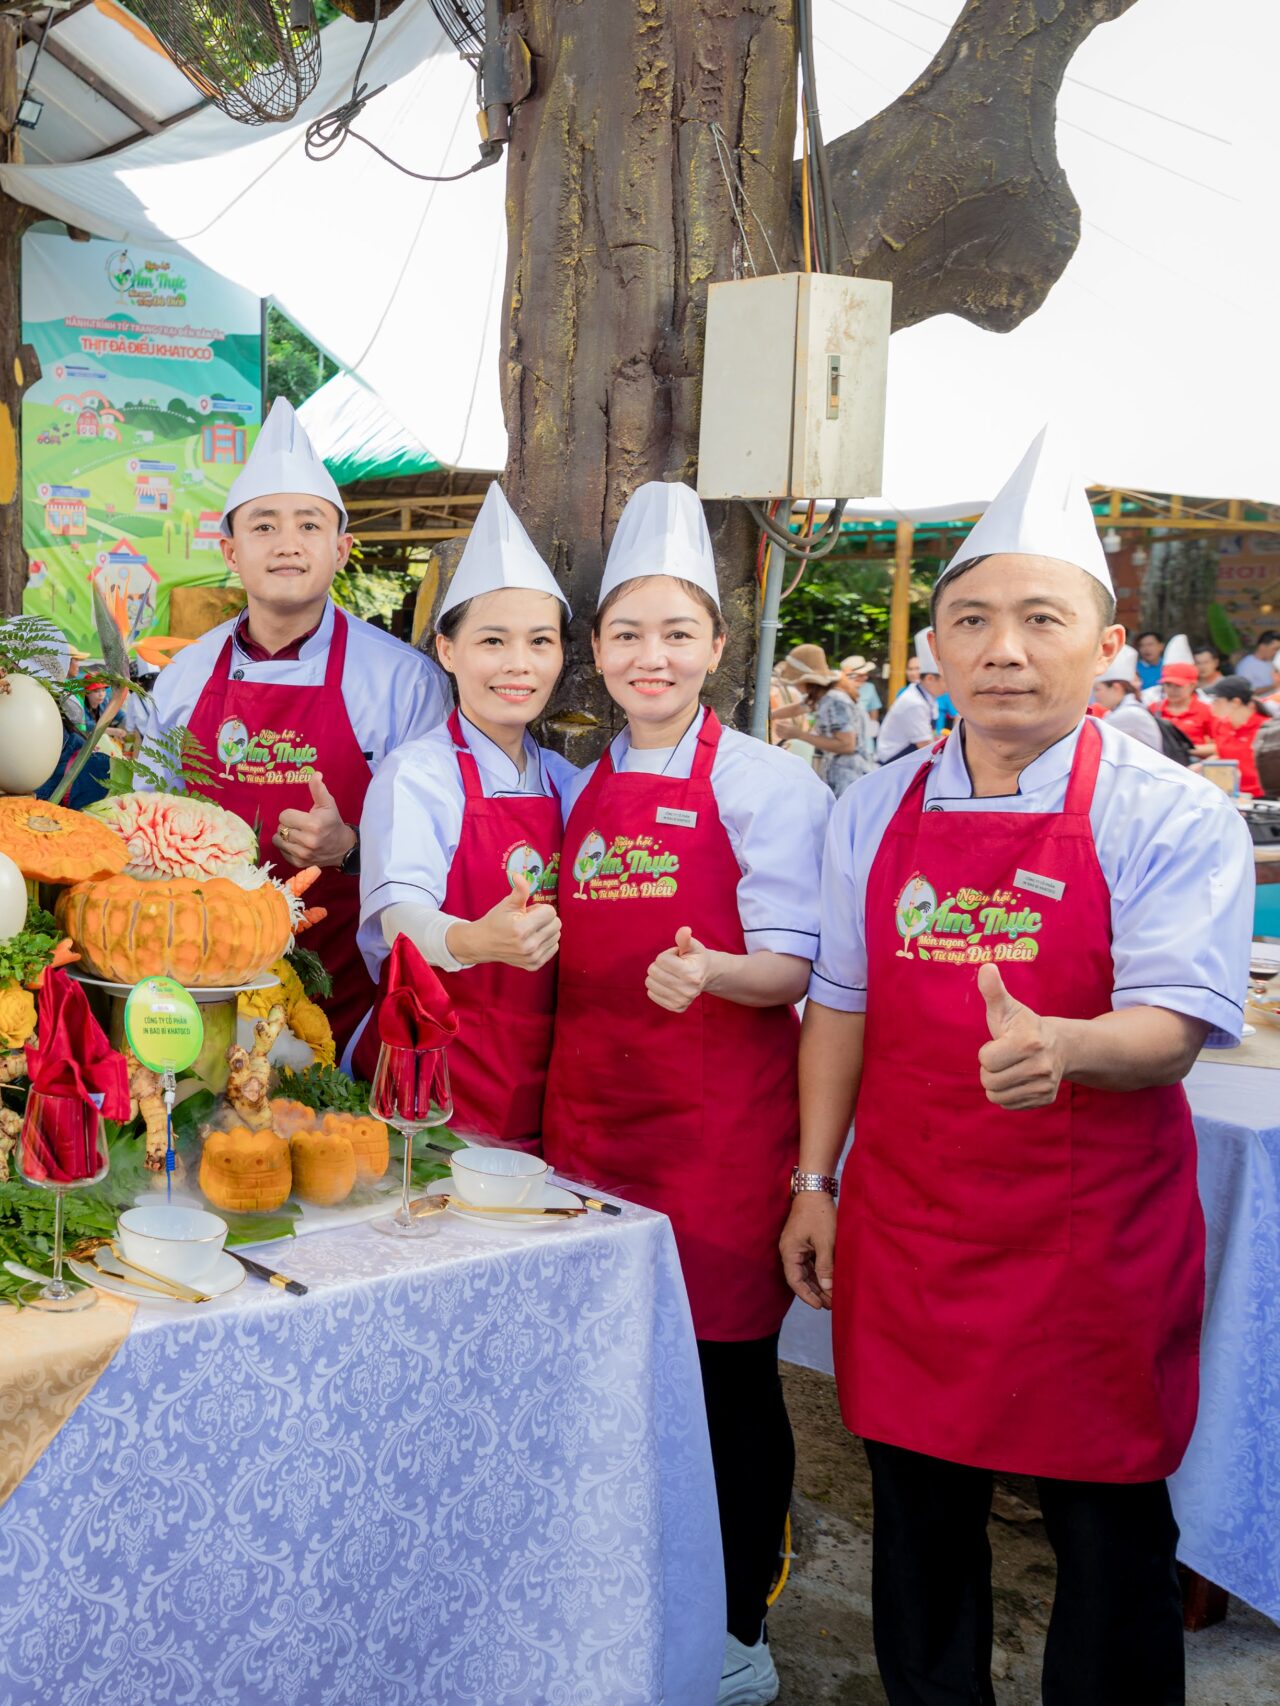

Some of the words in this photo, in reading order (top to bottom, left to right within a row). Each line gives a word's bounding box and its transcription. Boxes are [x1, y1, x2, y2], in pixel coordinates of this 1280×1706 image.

[81, 336, 108, 355] THỊT
[109, 336, 127, 353] ĐÀ
[156, 343, 211, 361] KHATOCO
[273, 742, 318, 767] Thực
[266, 770, 284, 783] Đà
[626, 850, 680, 879] Thực
[620, 882, 639, 898] Đà
[957, 887, 990, 905] Ngày
[991, 888, 1013, 906] hội
[978, 906, 1043, 939] Thực
[918, 934, 938, 946] Món
[938, 938, 966, 949] ngon
[947, 951, 966, 965] thịt
[966, 945, 992, 962] Đà
[144, 1015, 157, 1024] CÔNG
[168, 1027, 190, 1035] KHATOCO
